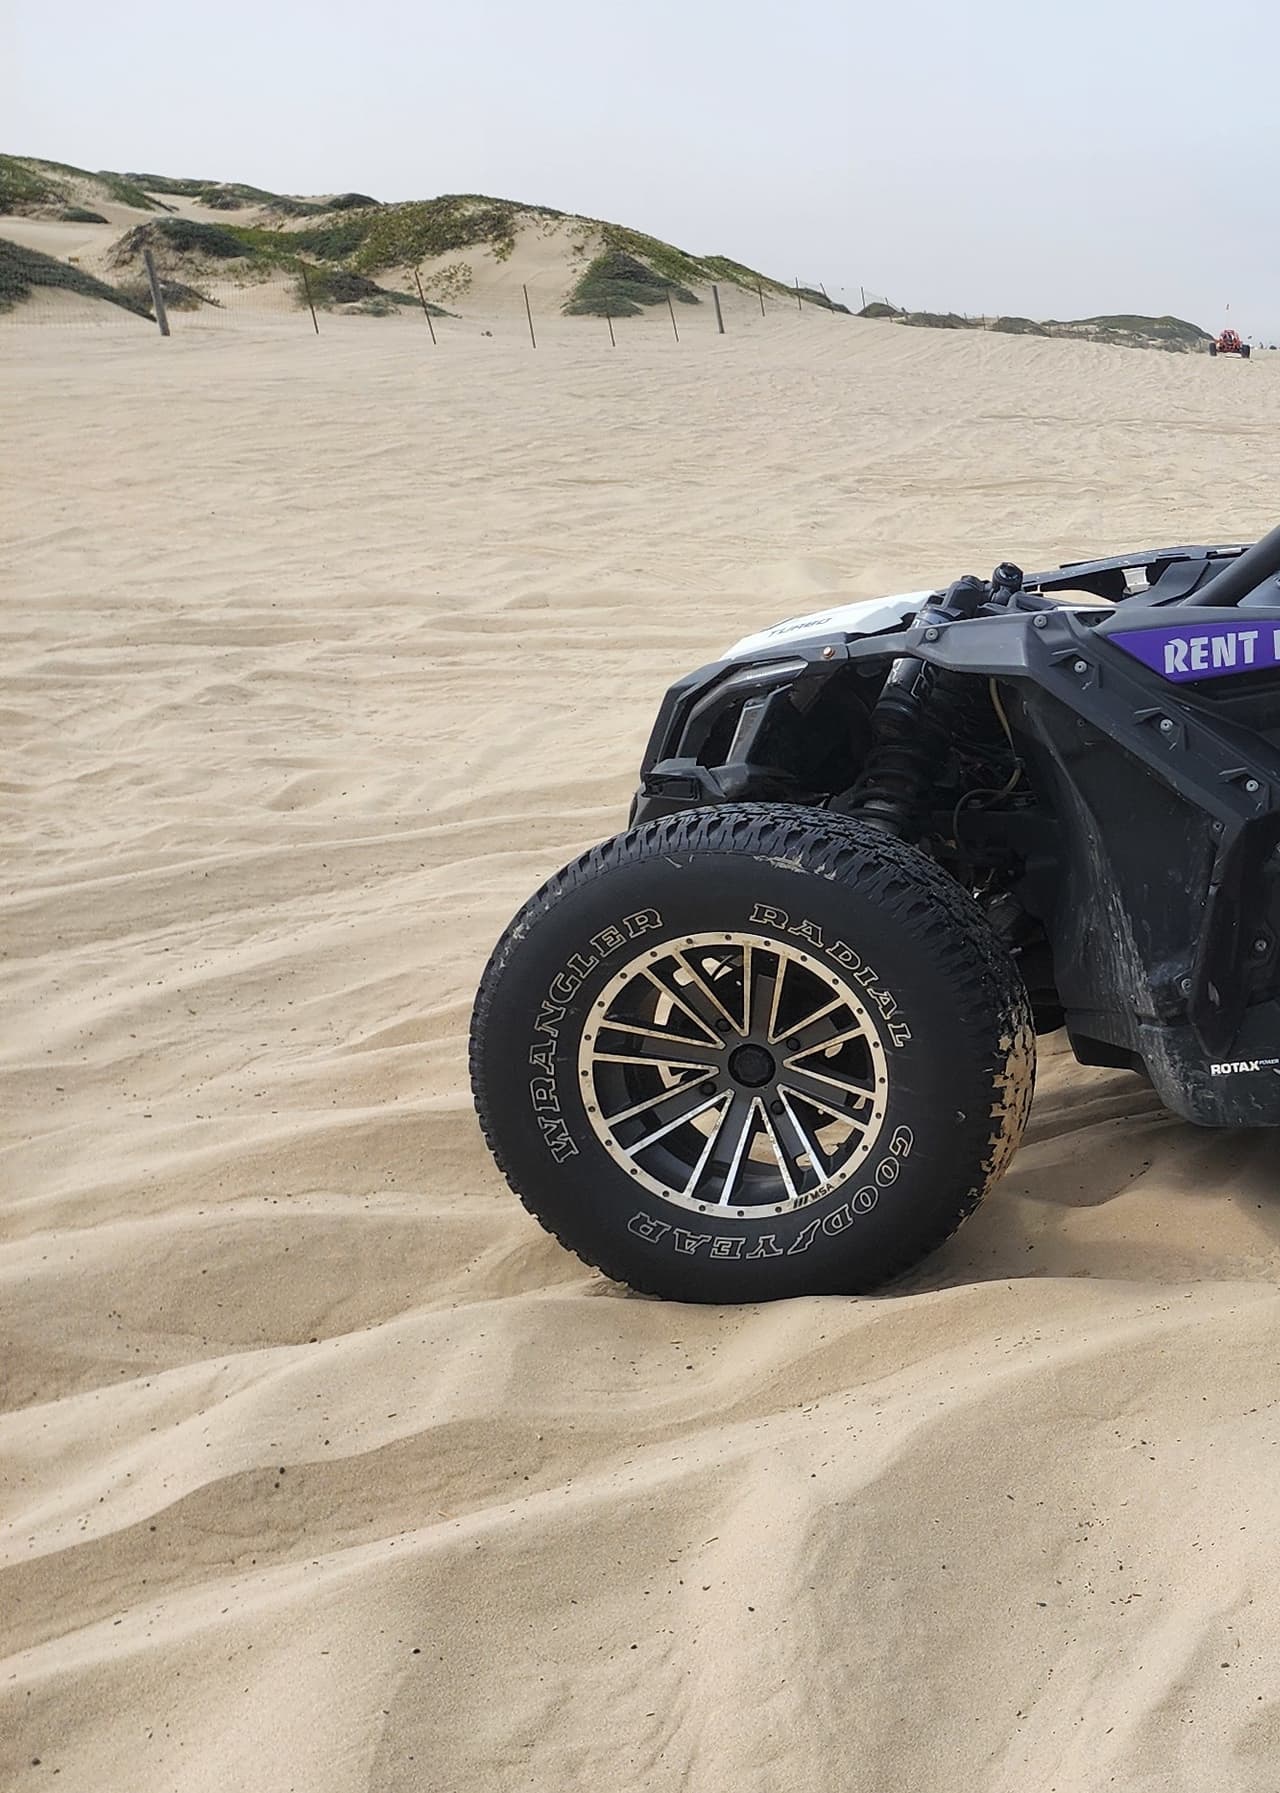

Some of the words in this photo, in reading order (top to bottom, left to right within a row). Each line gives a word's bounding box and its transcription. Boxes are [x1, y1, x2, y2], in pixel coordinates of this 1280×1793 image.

[1164, 631, 1258, 674] RENT
[749, 903, 914, 1048] RADIAL
[529, 907, 663, 1164] WRANGLER
[1210, 1060, 1260, 1077] ROTAX
